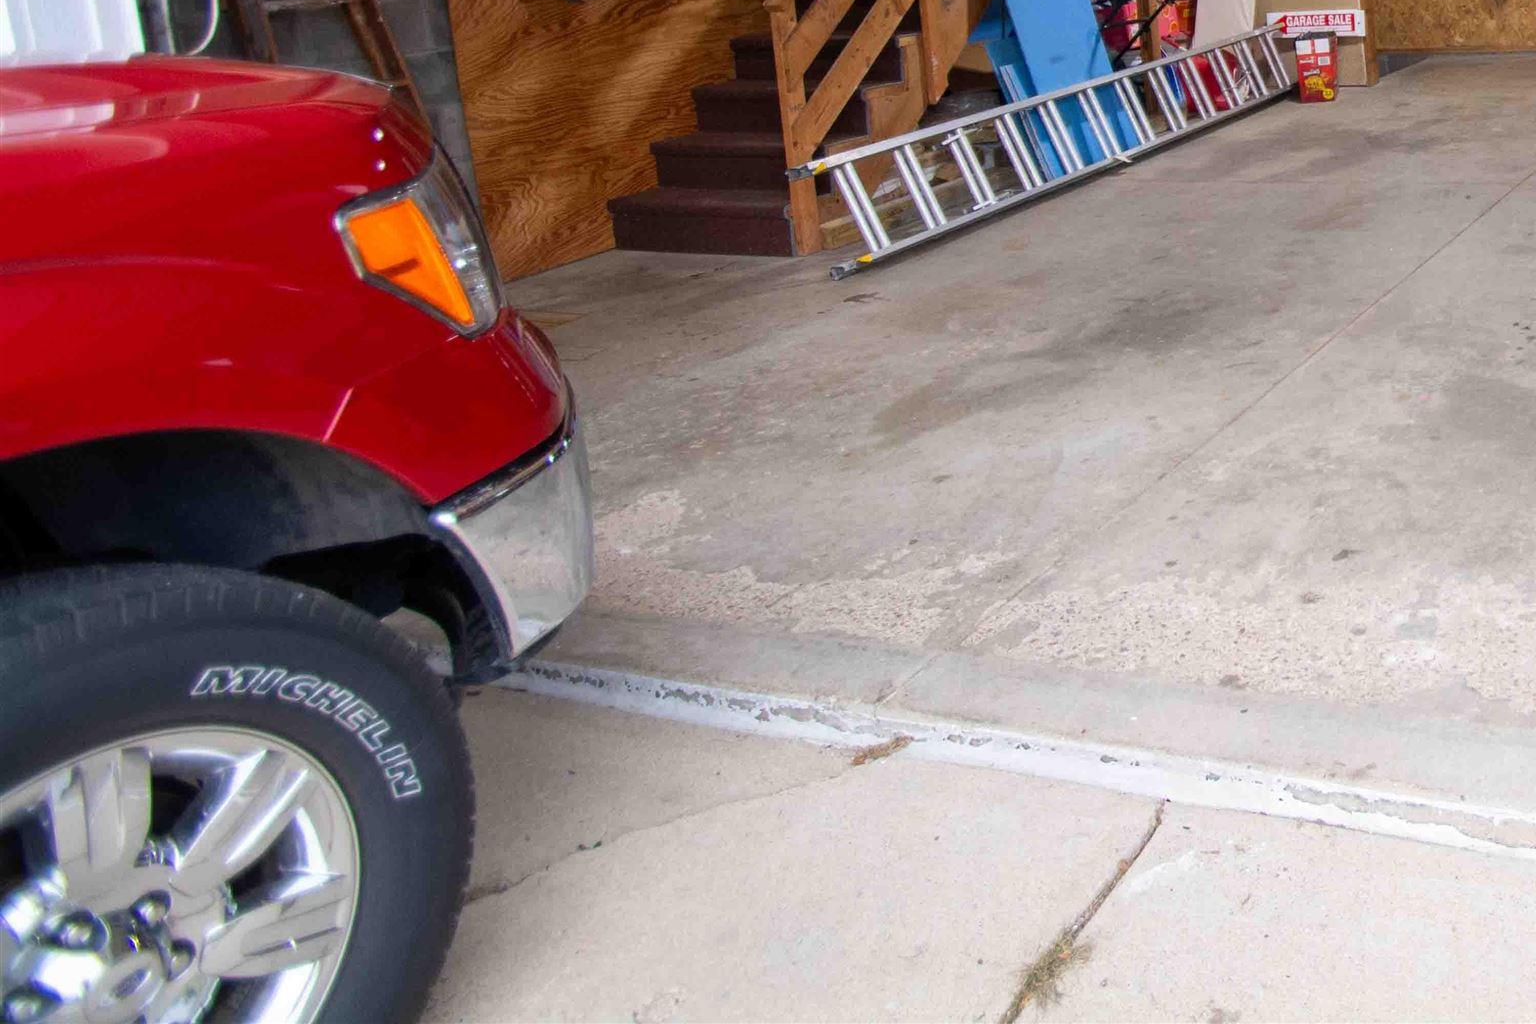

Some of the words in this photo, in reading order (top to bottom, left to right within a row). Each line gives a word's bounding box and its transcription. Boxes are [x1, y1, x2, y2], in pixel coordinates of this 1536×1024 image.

[1286, 15, 1326, 27] GARAGE
[1328, 14, 1352, 26] SALE
[190, 665, 422, 799] MICHELIN
